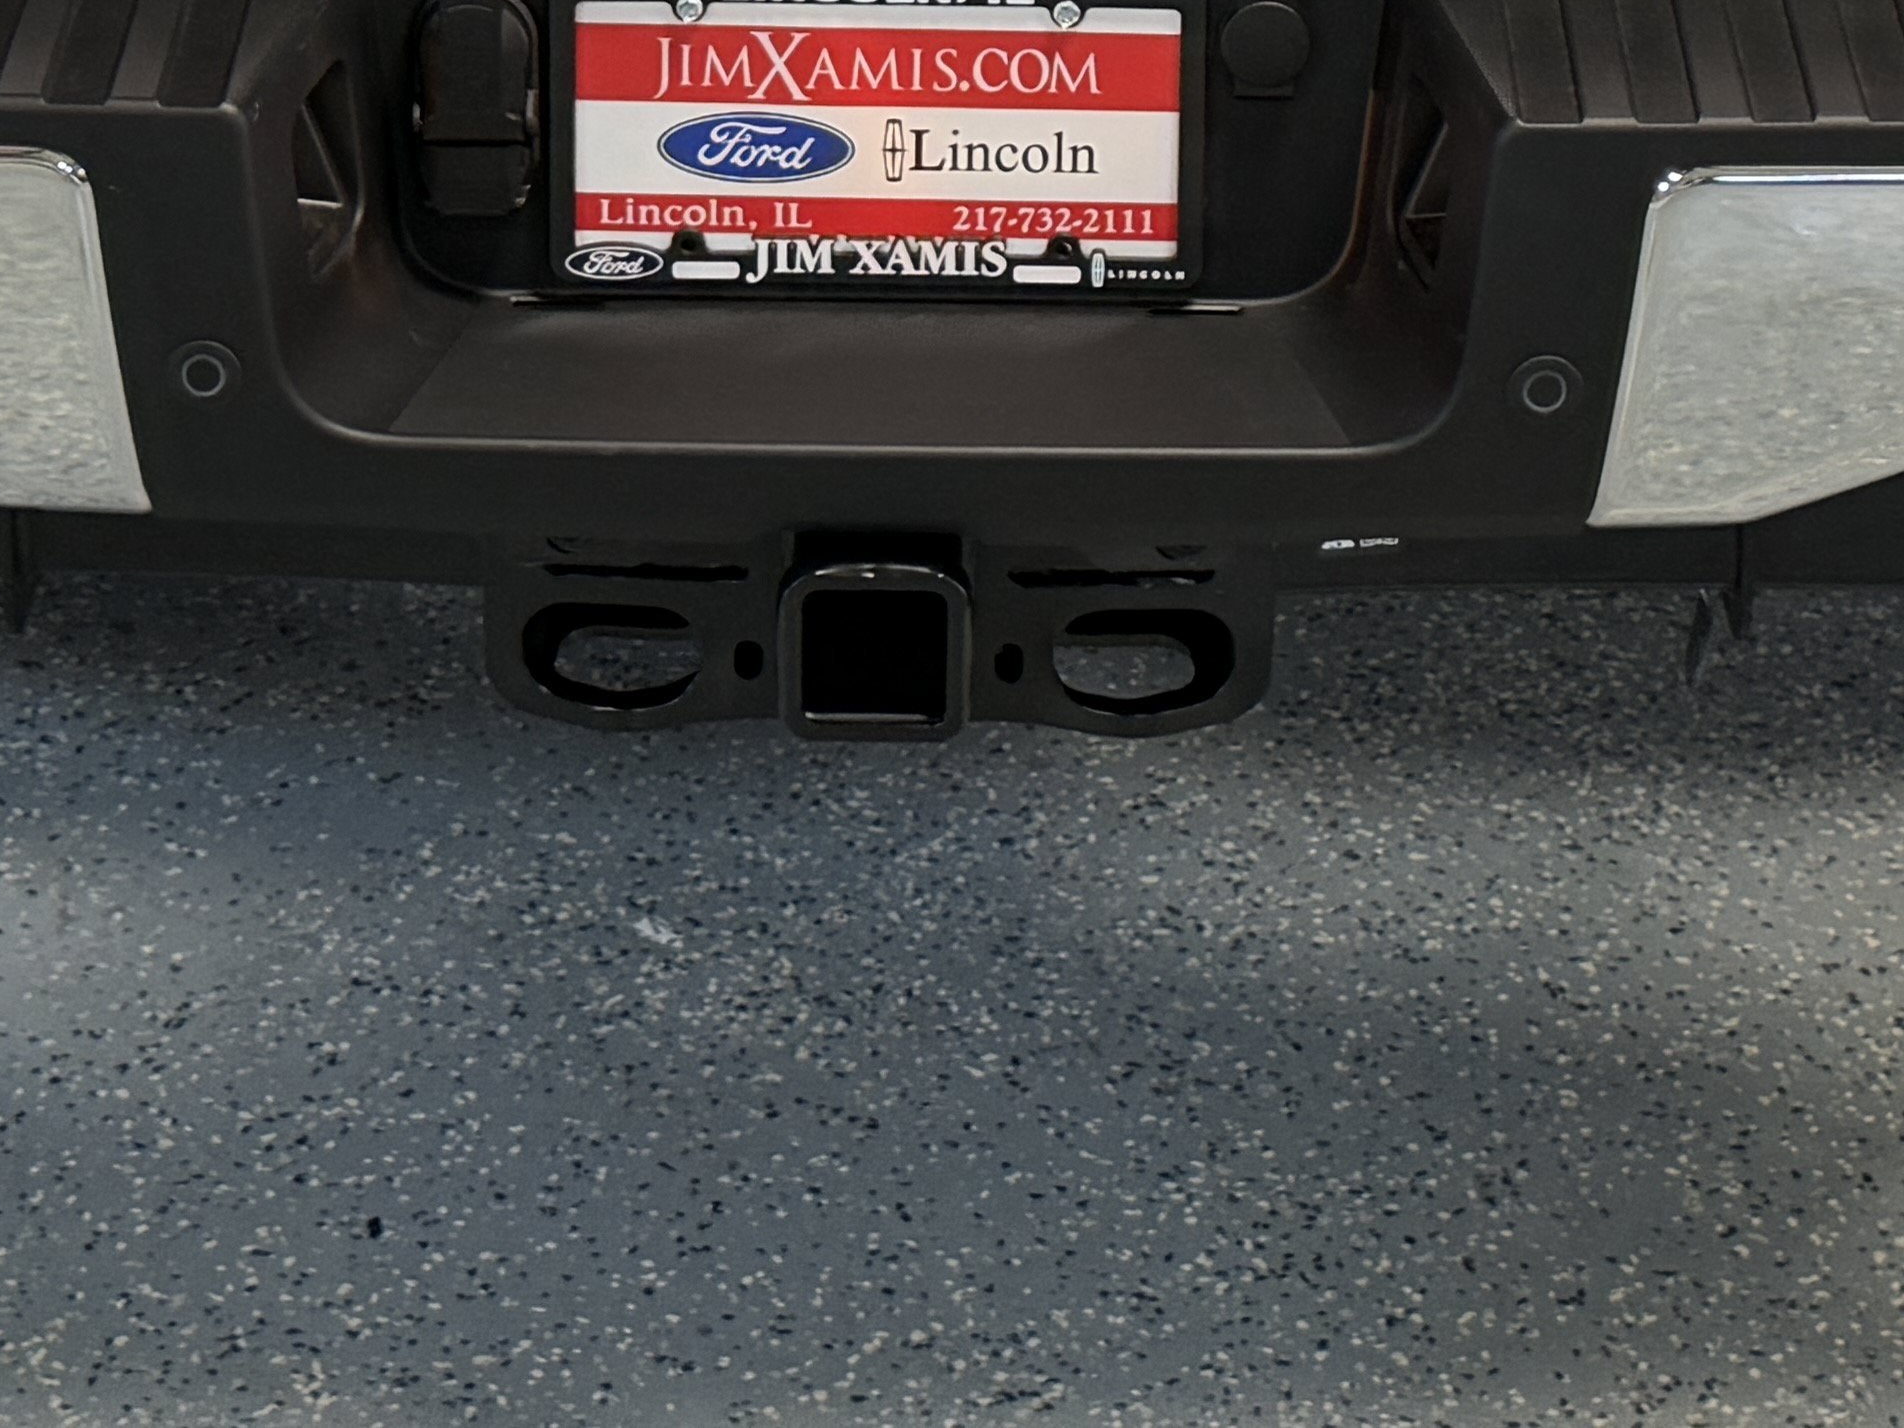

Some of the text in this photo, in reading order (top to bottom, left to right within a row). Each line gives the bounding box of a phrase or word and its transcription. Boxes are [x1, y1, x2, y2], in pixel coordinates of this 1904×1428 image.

[653, 31, 1103, 101] JIMXAMIS.COM
[697, 121, 1099, 175] Ford Lincoln
[599, 198, 813, 231] Lincoln, IL
[953, 205, 1154, 234] 217-732-2111
[583, 250, 644, 275] Ford
[745, 238, 1008, 284] JIM XAMIS
